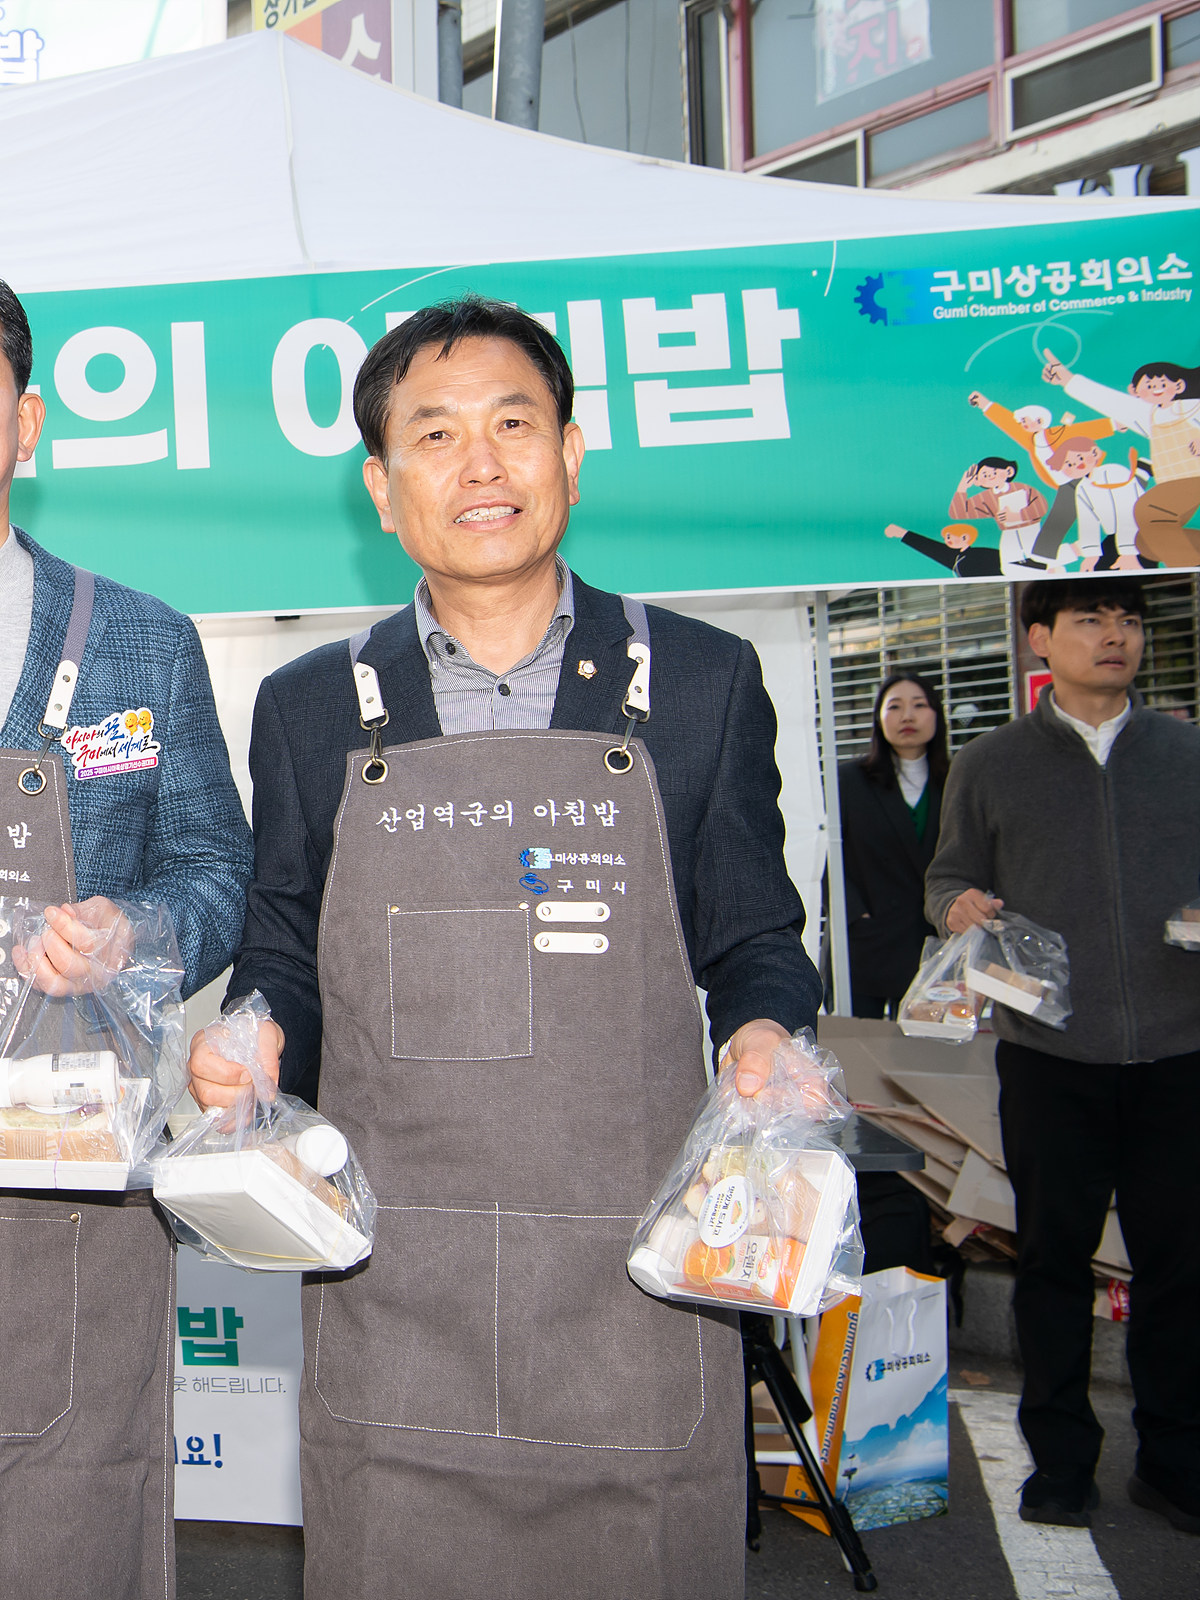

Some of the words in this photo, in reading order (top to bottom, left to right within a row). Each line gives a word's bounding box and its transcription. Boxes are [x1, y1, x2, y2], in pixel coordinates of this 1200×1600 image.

[930, 252, 1193, 302] 구미상공회의소
[933, 303, 968, 319] Gumi
[969, 301, 1031, 318] Chamber
[1033, 300, 1047, 313] of
[1049, 293, 1125, 312] Commerce
[1127, 291, 1138, 303] &
[1141, 286, 1193, 303] Industry
[376, 799, 514, 833] 산업역군의
[533, 799, 620, 827] 아침밥
[546, 851, 627, 867] 구미상공회의소
[192, 1376, 287, 1394] 해드립니다.
